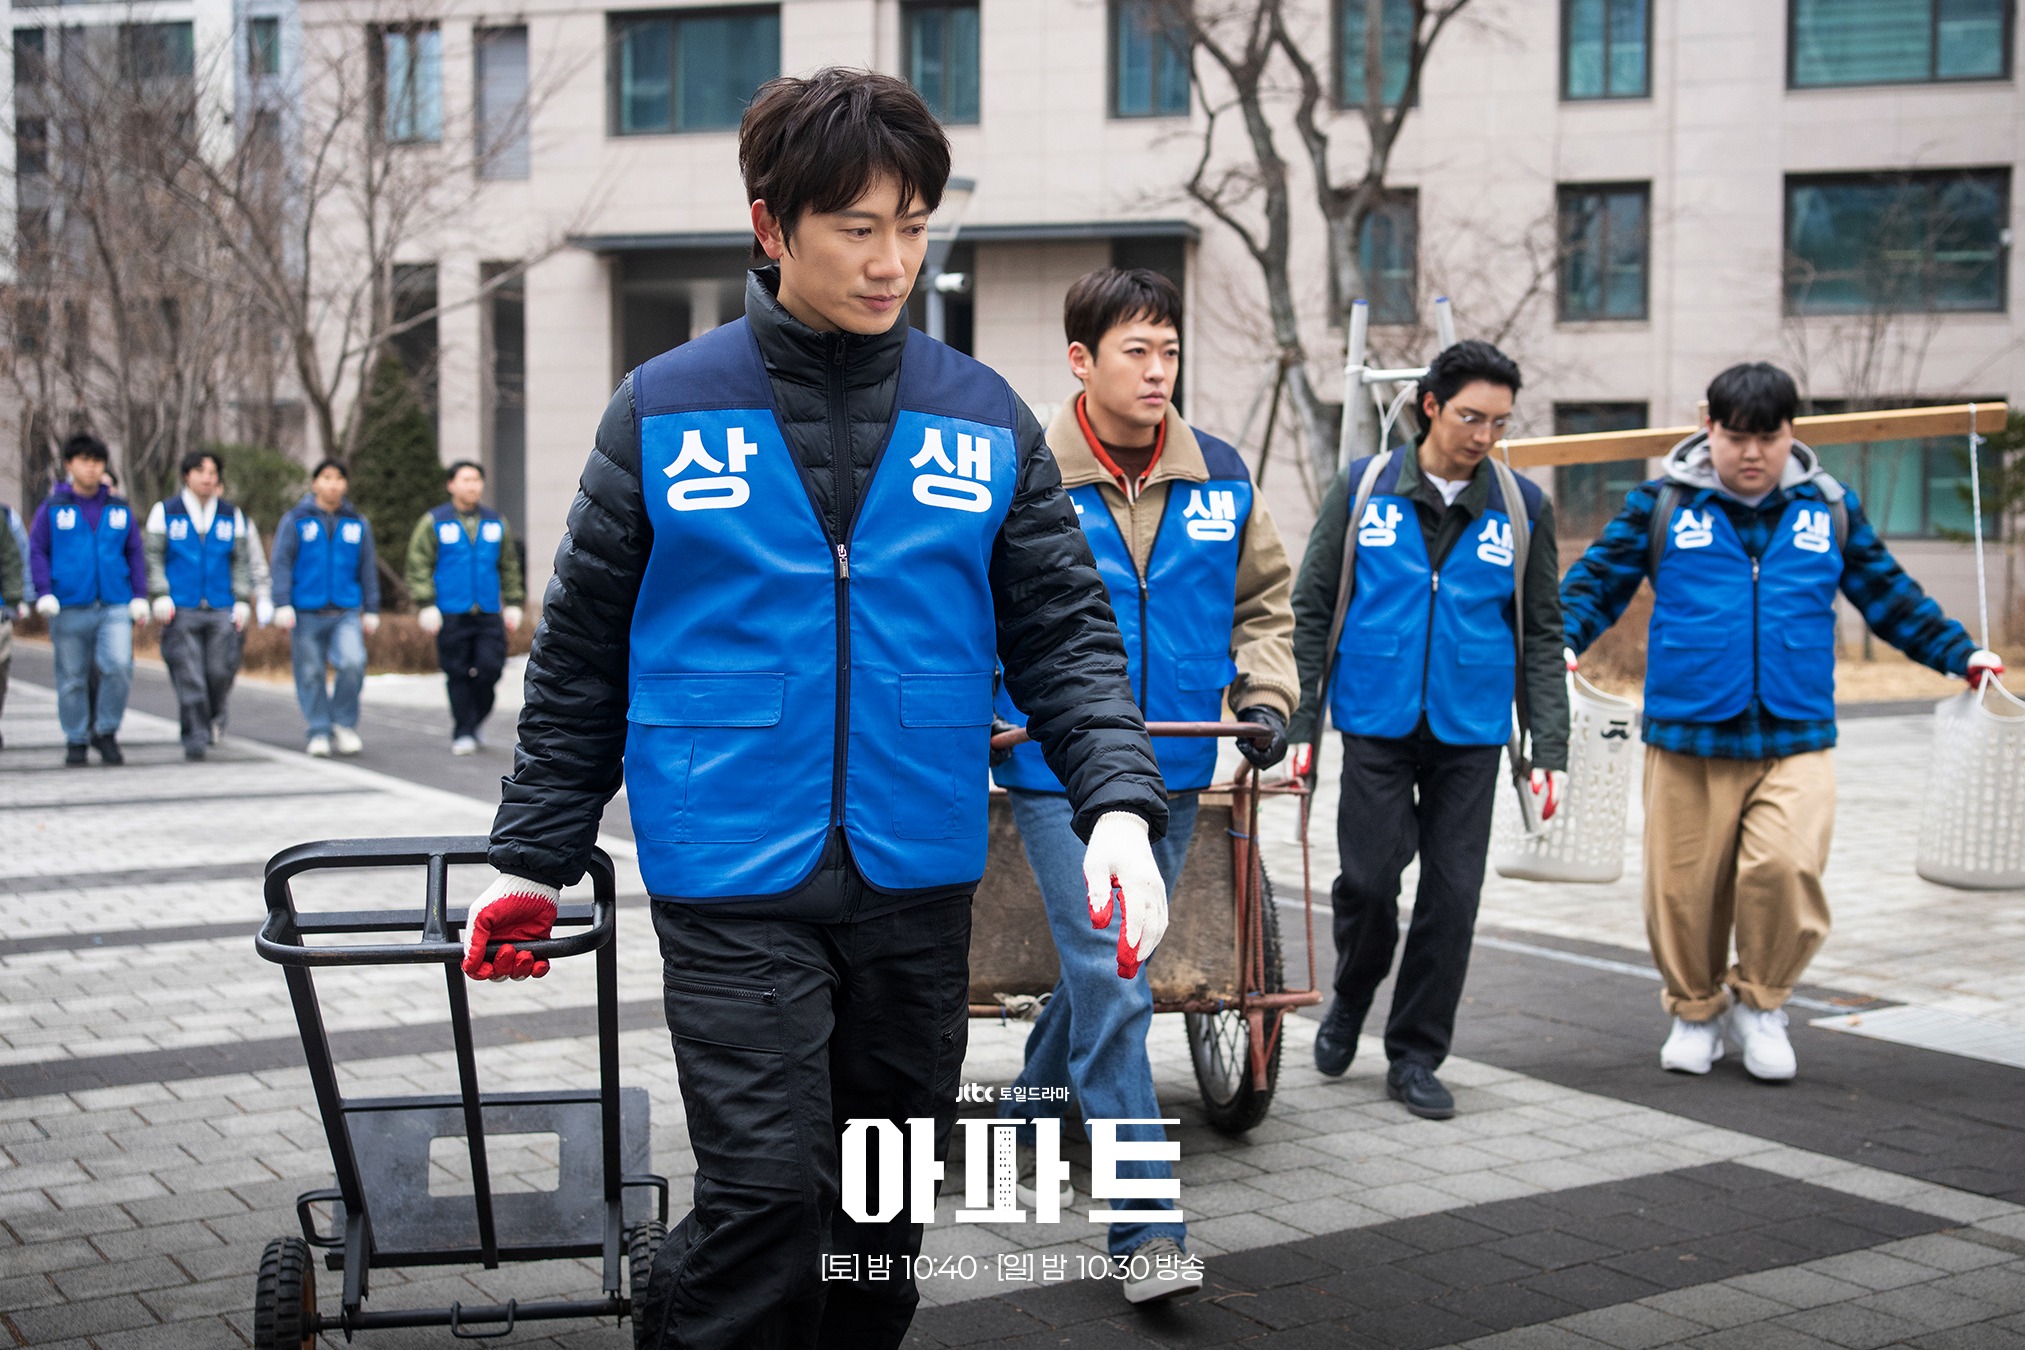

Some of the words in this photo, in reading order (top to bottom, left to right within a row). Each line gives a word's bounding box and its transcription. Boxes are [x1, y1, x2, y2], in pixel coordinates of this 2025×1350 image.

[662, 426, 759, 513] 상
[909, 427, 993, 514] 생
[1182, 489, 1237, 541] 생
[1358, 503, 1404, 547] 상
[1673, 508, 1715, 549] 상
[1791, 509, 1831, 553] 생
